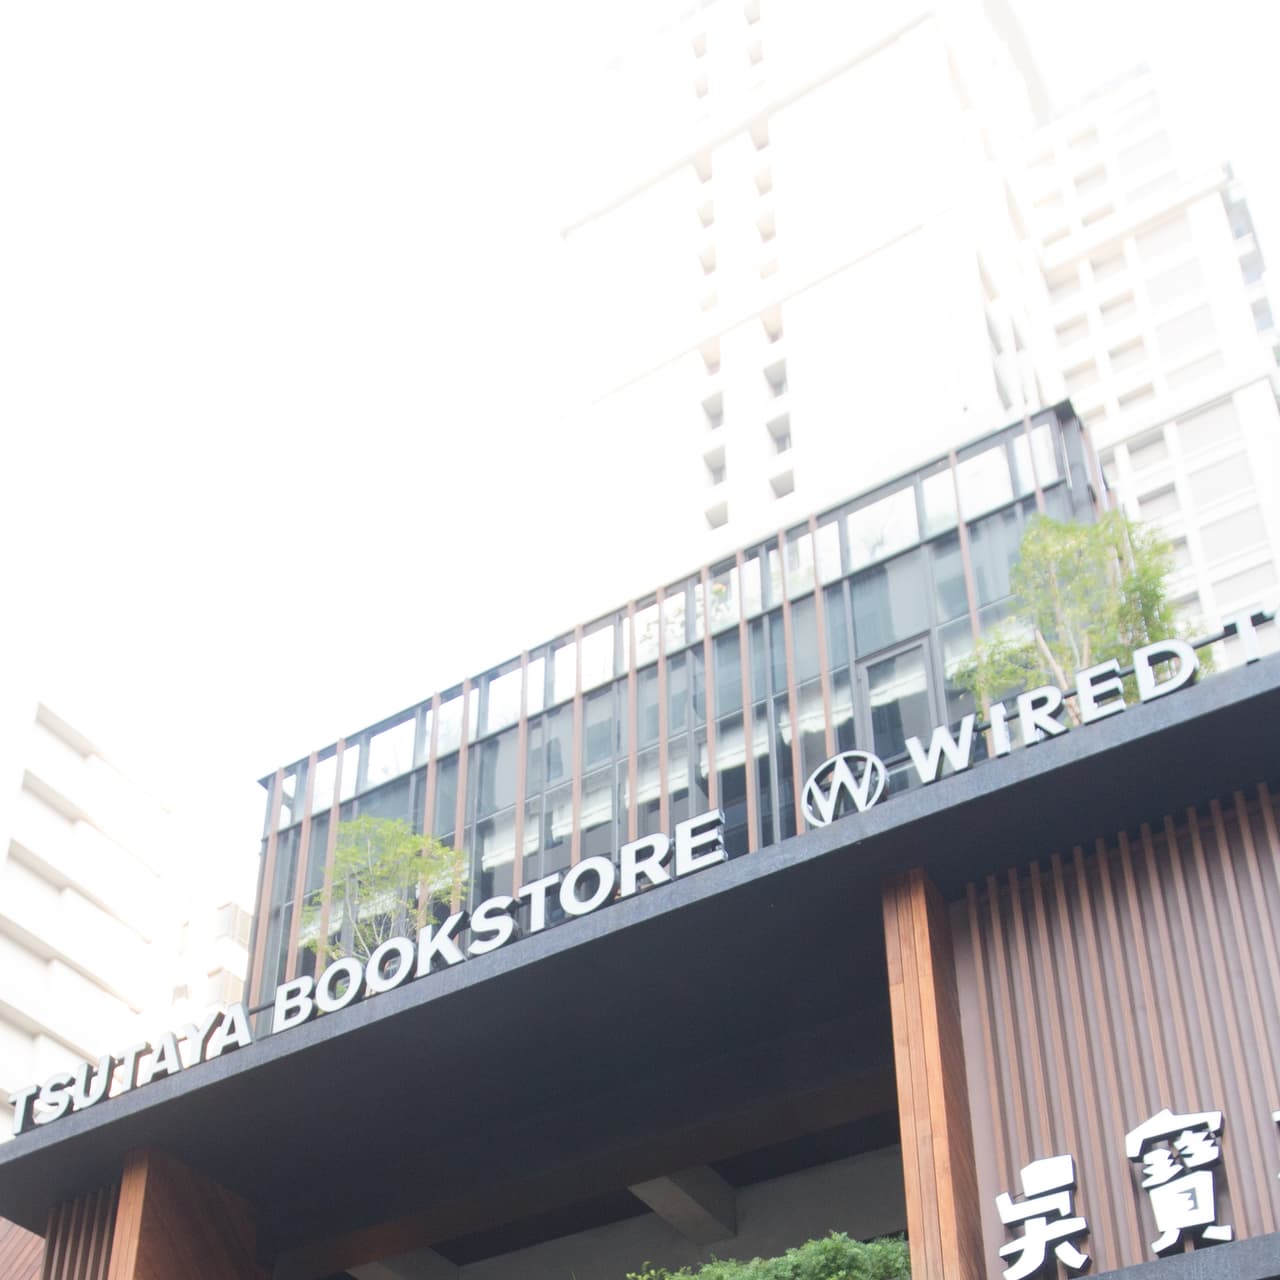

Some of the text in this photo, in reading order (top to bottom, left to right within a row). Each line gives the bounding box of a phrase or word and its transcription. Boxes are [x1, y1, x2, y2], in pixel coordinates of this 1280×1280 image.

[906, 638, 1199, 783] WIRED
[8, 809, 728, 1136] TSUTAYA BOOKSTORE
